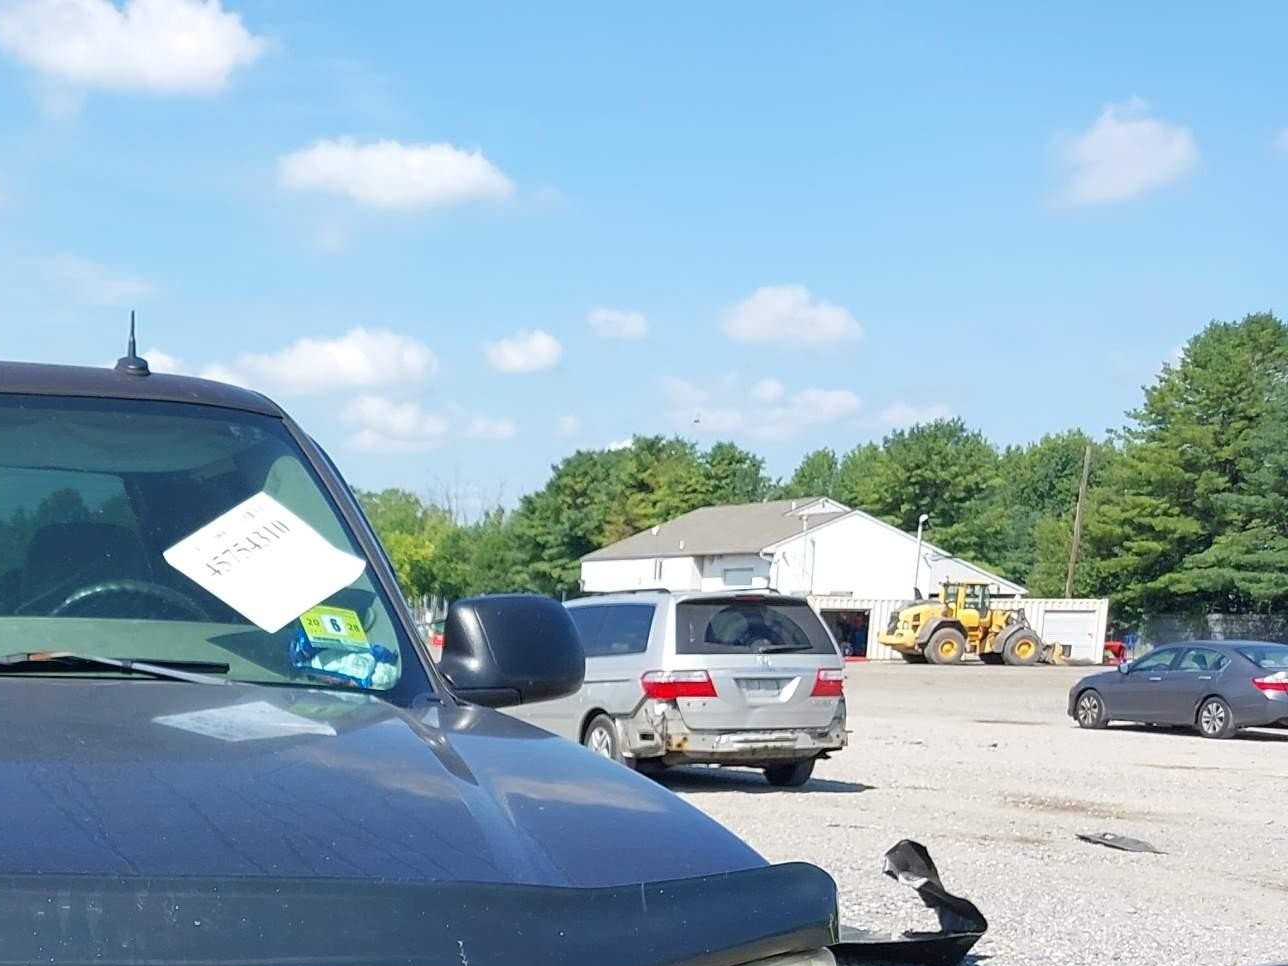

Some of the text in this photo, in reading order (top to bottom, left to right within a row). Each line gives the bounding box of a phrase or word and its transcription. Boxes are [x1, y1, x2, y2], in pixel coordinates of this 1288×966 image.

[205, 519, 290, 577] 45754310
[306, 618, 319, 626] 20
[330, 619, 340, 632] 6
